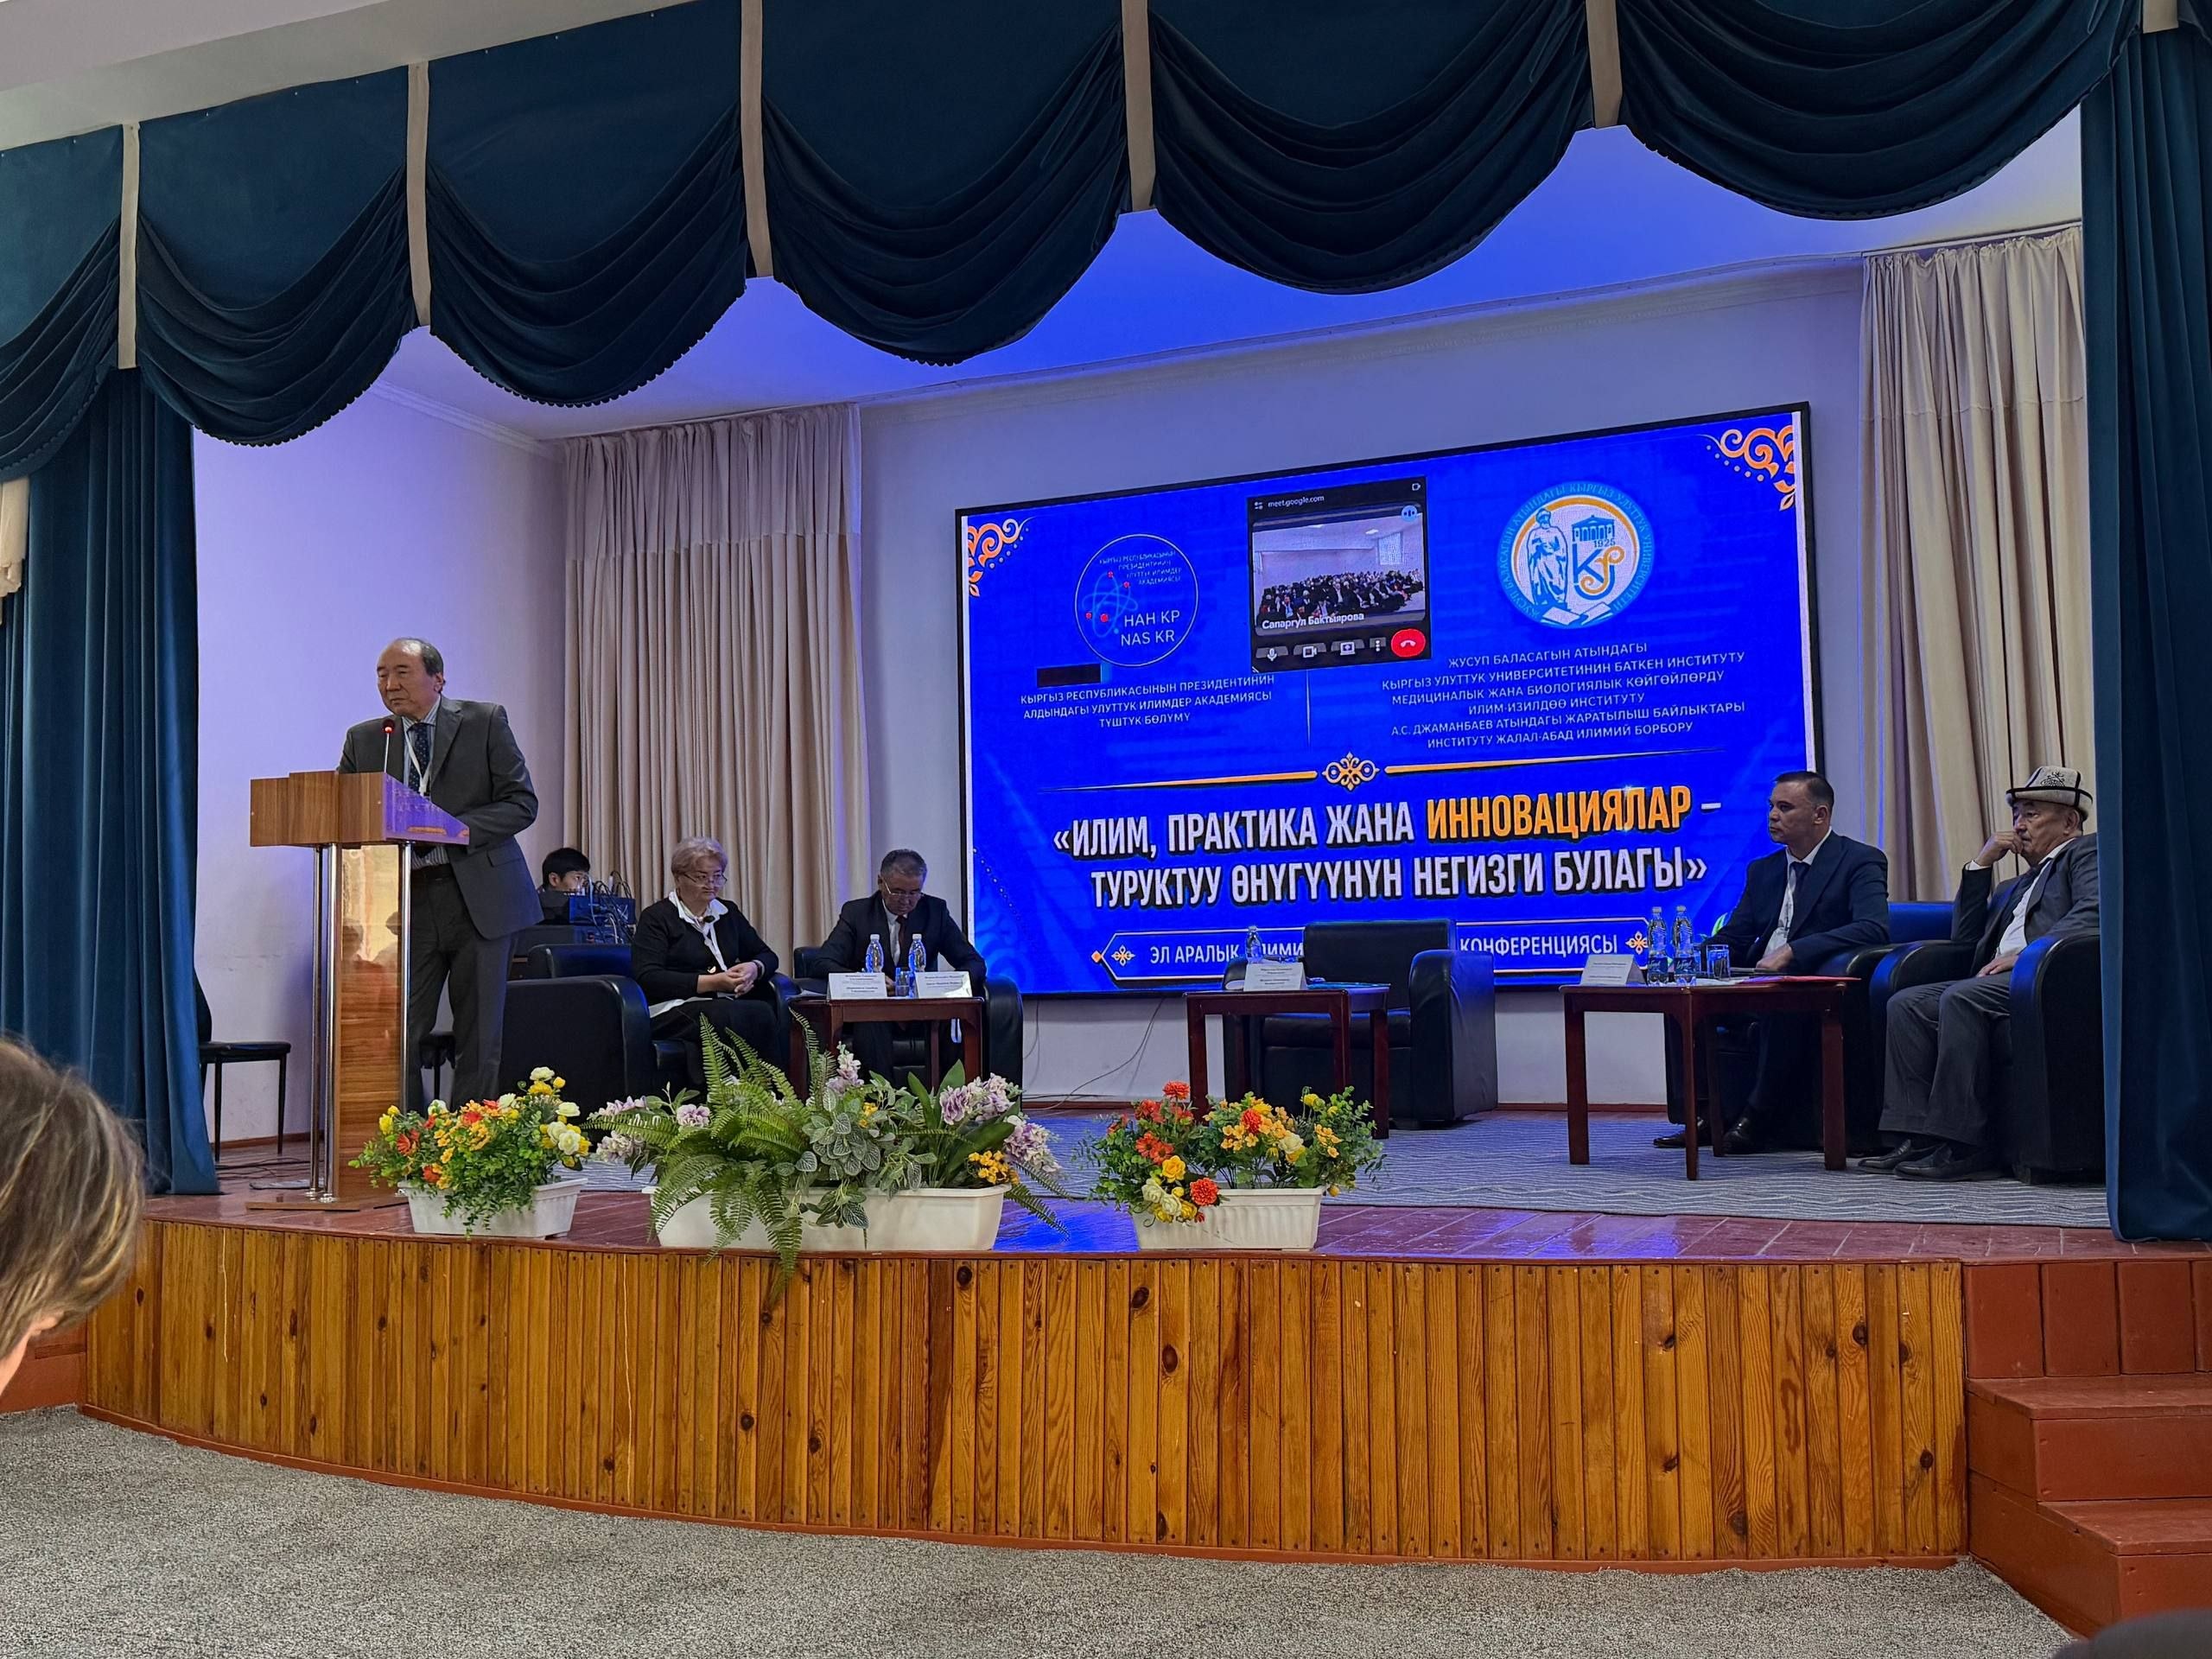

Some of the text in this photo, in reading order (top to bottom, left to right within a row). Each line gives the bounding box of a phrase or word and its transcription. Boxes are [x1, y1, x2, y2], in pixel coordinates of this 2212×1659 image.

[1268, 495, 1325, 508] meet.google.com
[1570, 483, 1614, 498] КЫРГЫЗ
[1514, 486, 1565, 526] АТЫНДАГЫ
[1617, 493, 1648, 532] УЛУТТУК
[1593, 538, 1616, 548] 1925
[1500, 528, 1514, 591] БАЛАСАГЫН
[1612, 532, 1653, 611] УНИВЕРСИТЕТИ
[1124, 609, 1180, 627] НАН КР
[1262, 612, 1364, 630] Сапаргул Бактыярова
[1121, 629, 1175, 646] NAS KR
[1448, 643, 1647, 668] ЖУСУП БАЛАСАГЫН АТЫНДАГЫ
[1382, 652, 1745, 690] КЫРГЫЗ УЛУТТУК УНИВЕРСИТЕТИНИН БАТКЕН ИНСТИТУТУ
[1020, 674, 1274, 705] КЫРГЫЗ РЕСПУБЛИКАСЫНЫН ПРЕЗИДЕНТИНИН
[1392, 671, 1725, 705] МЕДИЦИНАЛЫК ЖАНА БИОЛОГИЯЛЫК КӨЙГӨЙЛӨРДУ
[1023, 690, 1272, 720] АЛДЫНДАГЫ УЛУТТУК ИЛИМДЕР АКАДЕМИЯСЫ
[1391, 702, 1745, 735] А.С. ДЖАМАНБАЕВ АТЫНДАГЫ ЖАРАТЫЛЫШ БАЙЛЫКТАРЫ
[1468, 693, 1644, 715] ИЛИМ-ИЗИЛДӨӨ ИНСТИТУТУ
[1099, 713, 1191, 728] ТҮШТҮК БӨЛҮМҮ
[1427, 721, 1693, 749] ИНСТИТУТУ ЖАЛАЛ-АБАД ИЛИМИЙ БОРБОРУ
[1053, 816, 1157, 858] «ИЛИМ,
[1168, 806, 1317, 852] ПРАКТИКА
[1326, 800, 1414, 845] ЖАНА
[1427, 785, 1691, 839] ИННОВАЦИЯЛАР
[1090, 846, 1707, 908] ТУРУКТУУ ӨНҮГҮҮНҮН НЕГИЗГИ БУЛАГЫ»
[1150, 945, 1170, 964] ЭЛ
[1175, 943, 1239, 963] АРАЛЫК
[1460, 934, 1618, 957] КОНФЕРЕНЦИЯСЫ
